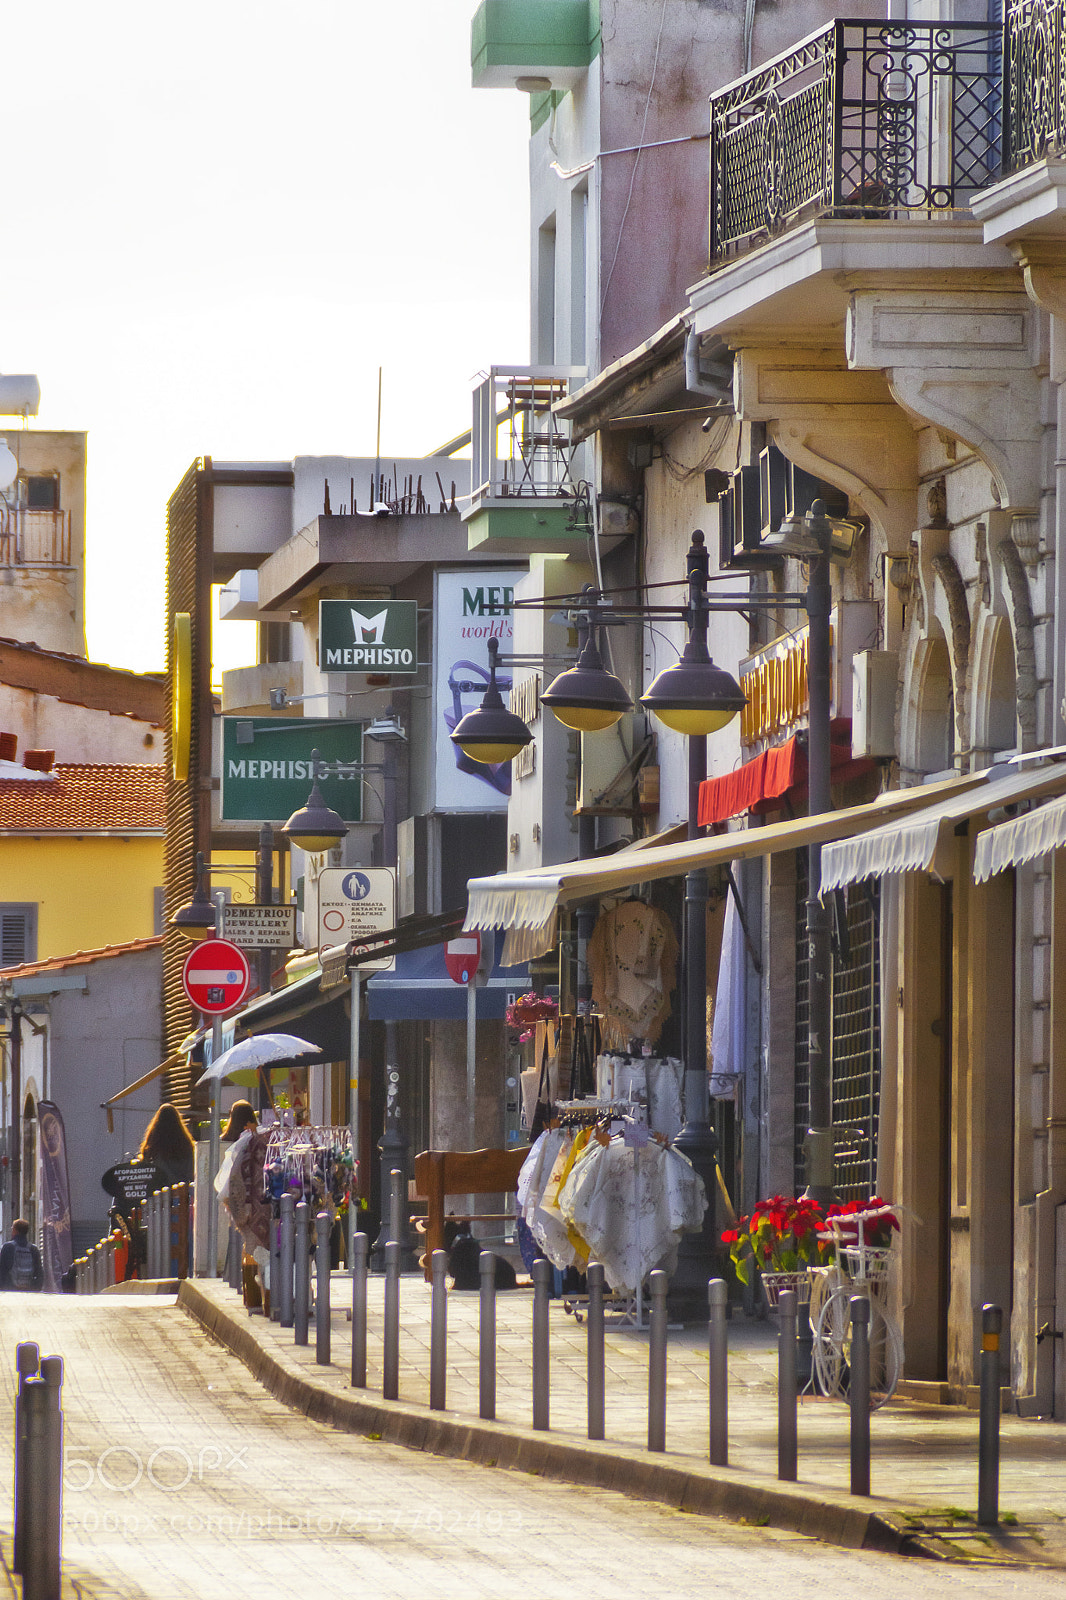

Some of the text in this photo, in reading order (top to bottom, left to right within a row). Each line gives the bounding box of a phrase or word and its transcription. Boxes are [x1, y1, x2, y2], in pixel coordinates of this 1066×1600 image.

[461, 620, 513, 638] world's
[326, 648, 413, 665] MEPHISTO
[225, 908, 292, 918] DEMETRIOU
[225, 919, 289, 927] JEWELLERY
